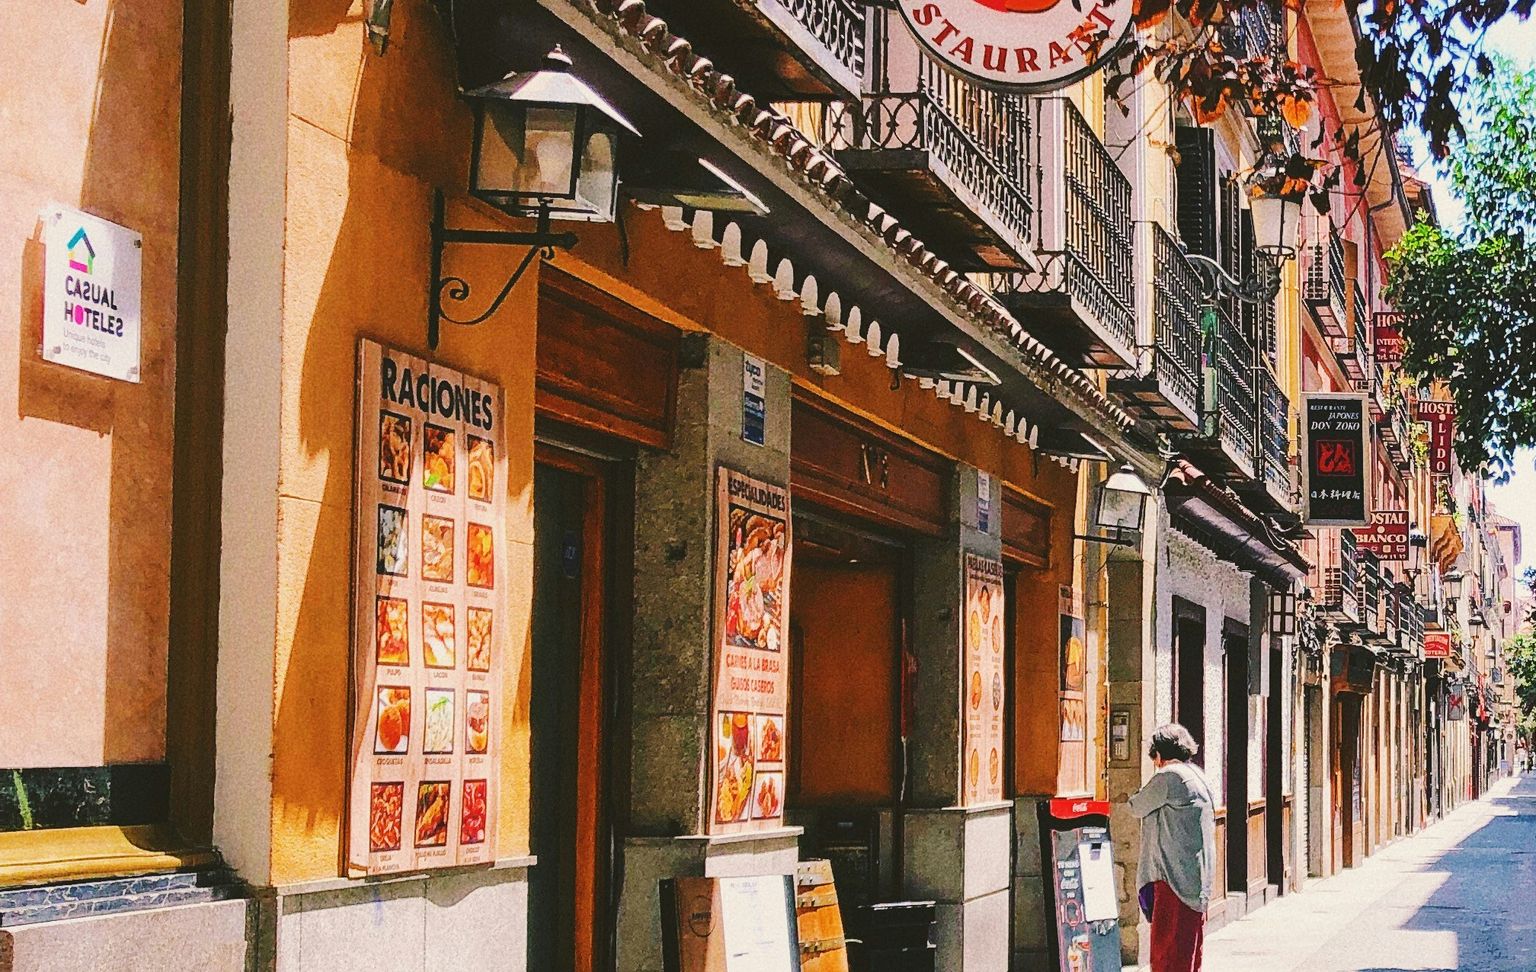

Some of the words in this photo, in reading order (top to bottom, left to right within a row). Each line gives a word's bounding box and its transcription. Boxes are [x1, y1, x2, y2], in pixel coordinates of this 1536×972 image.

[65, 275, 117, 310] CASUAL
[65, 300, 123, 337] HOTELES
[382, 357, 492, 431] RACIONES
[1419, 402, 1453, 414] HOST.
[1311, 421, 1332, 431] DON
[1335, 421, 1360, 431] ZOKO
[1328, 412, 1359, 421] JAPONES
[1436, 422, 1447, 472] LIDO
[728, 477, 786, 512] ESPECIALIDADES
[1355, 534, 1408, 543] BIANCO
